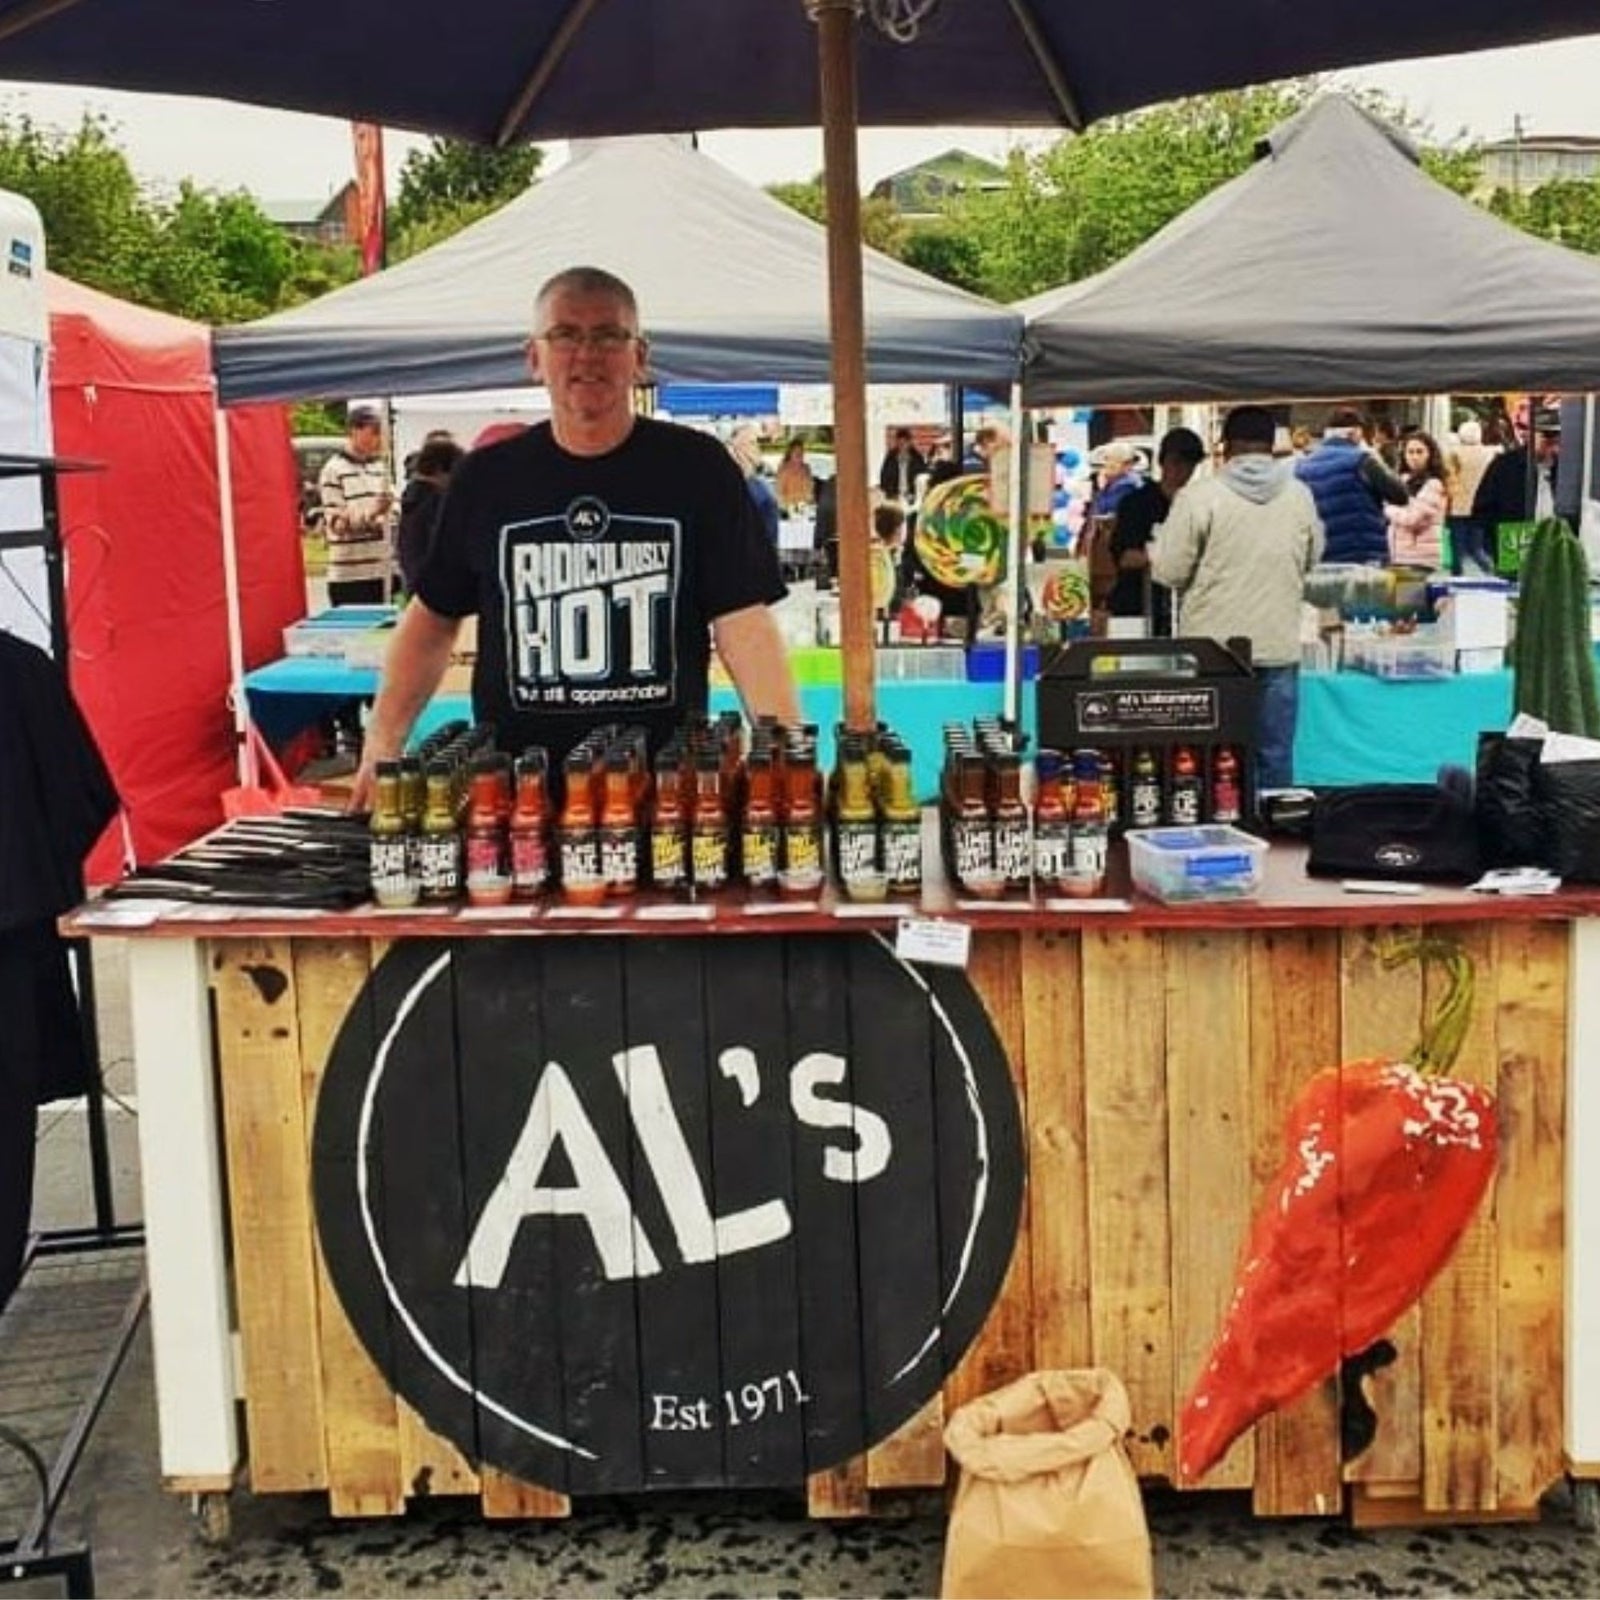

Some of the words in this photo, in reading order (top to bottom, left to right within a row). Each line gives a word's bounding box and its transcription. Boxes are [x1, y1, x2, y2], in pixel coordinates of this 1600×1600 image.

[512, 542, 671, 602] RIDICULOUSLY
[515, 574, 670, 680] HOT
[453, 1043, 893, 1289] AL's
[649, 1394, 713, 1431] Est
[724, 1368, 811, 1426] 1971
